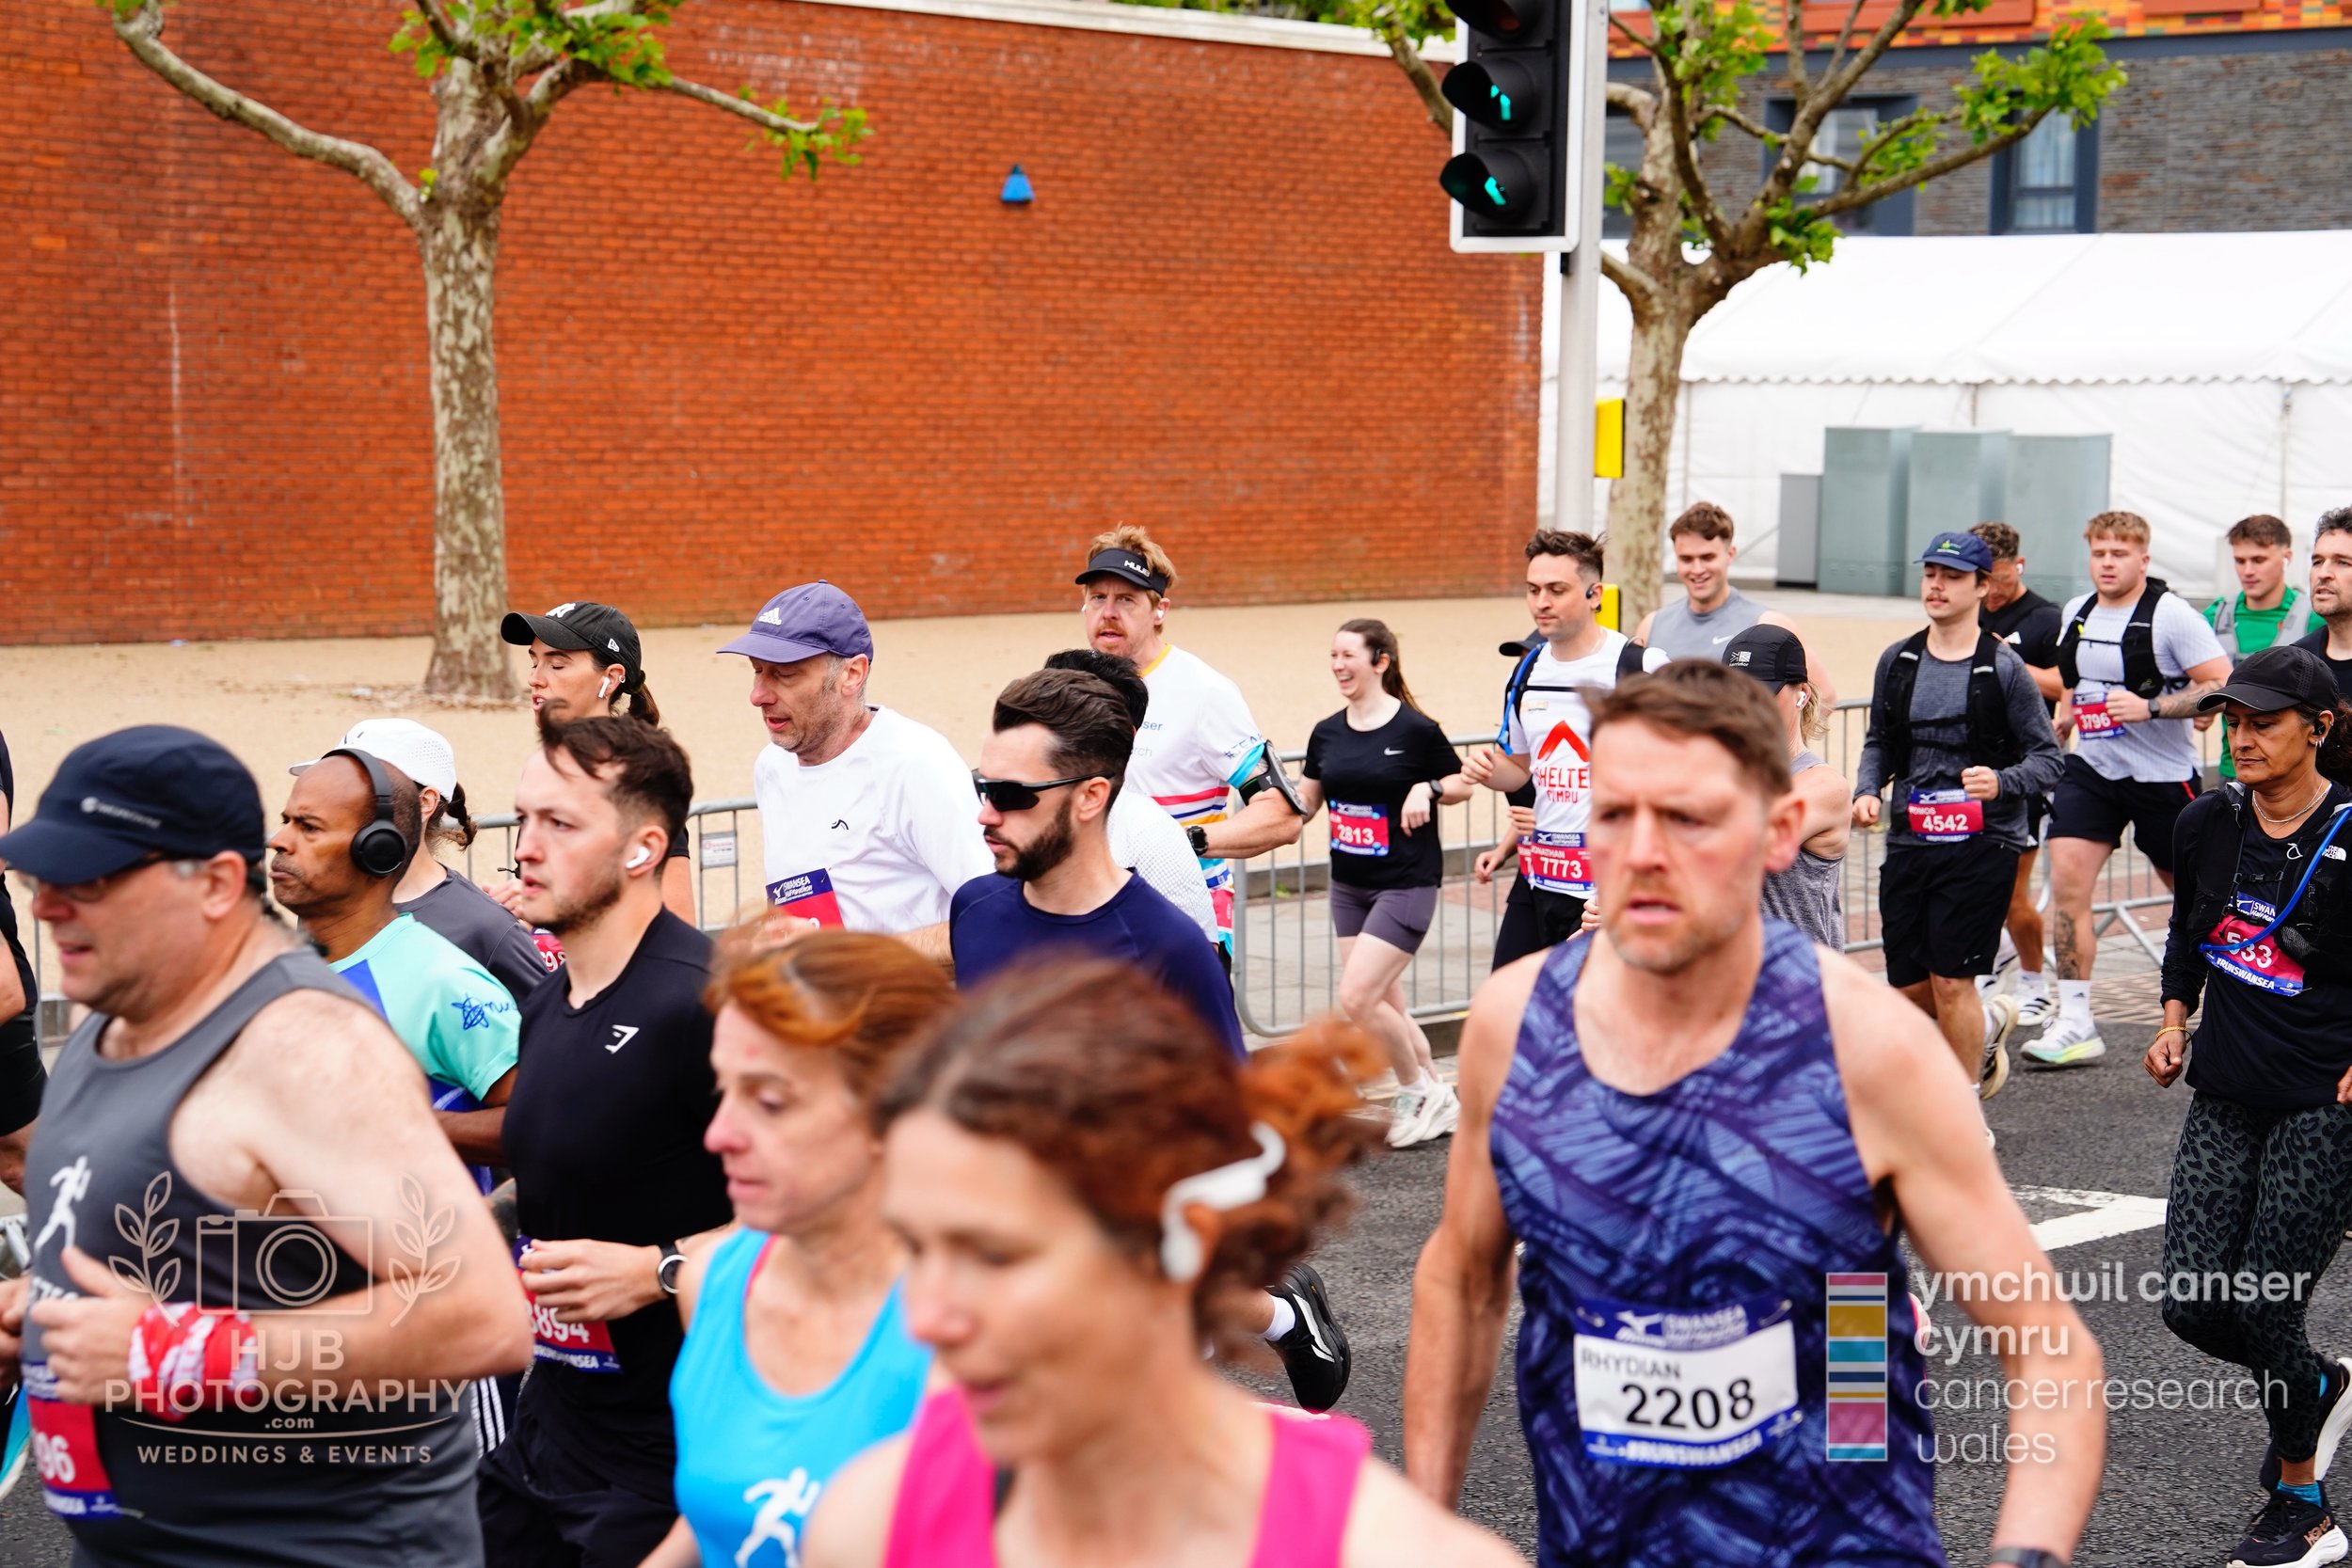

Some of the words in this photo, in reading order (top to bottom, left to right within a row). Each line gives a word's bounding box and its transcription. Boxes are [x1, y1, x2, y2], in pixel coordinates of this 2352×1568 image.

[1123, 560, 1151, 578] HUUB
[1534, 767, 1591, 788] SHELTE
[1922, 814, 1969, 832] 4542
[1337, 824, 1375, 846] 2813
[1539, 857, 1583, 879] 7773
[783, 875, 811, 892] SWANSEA
[2253, 902, 2276, 918] SWAN
[1581, 1347, 1682, 1380] RHYDIAN
[1621, 1378, 1756, 1431] 2208
